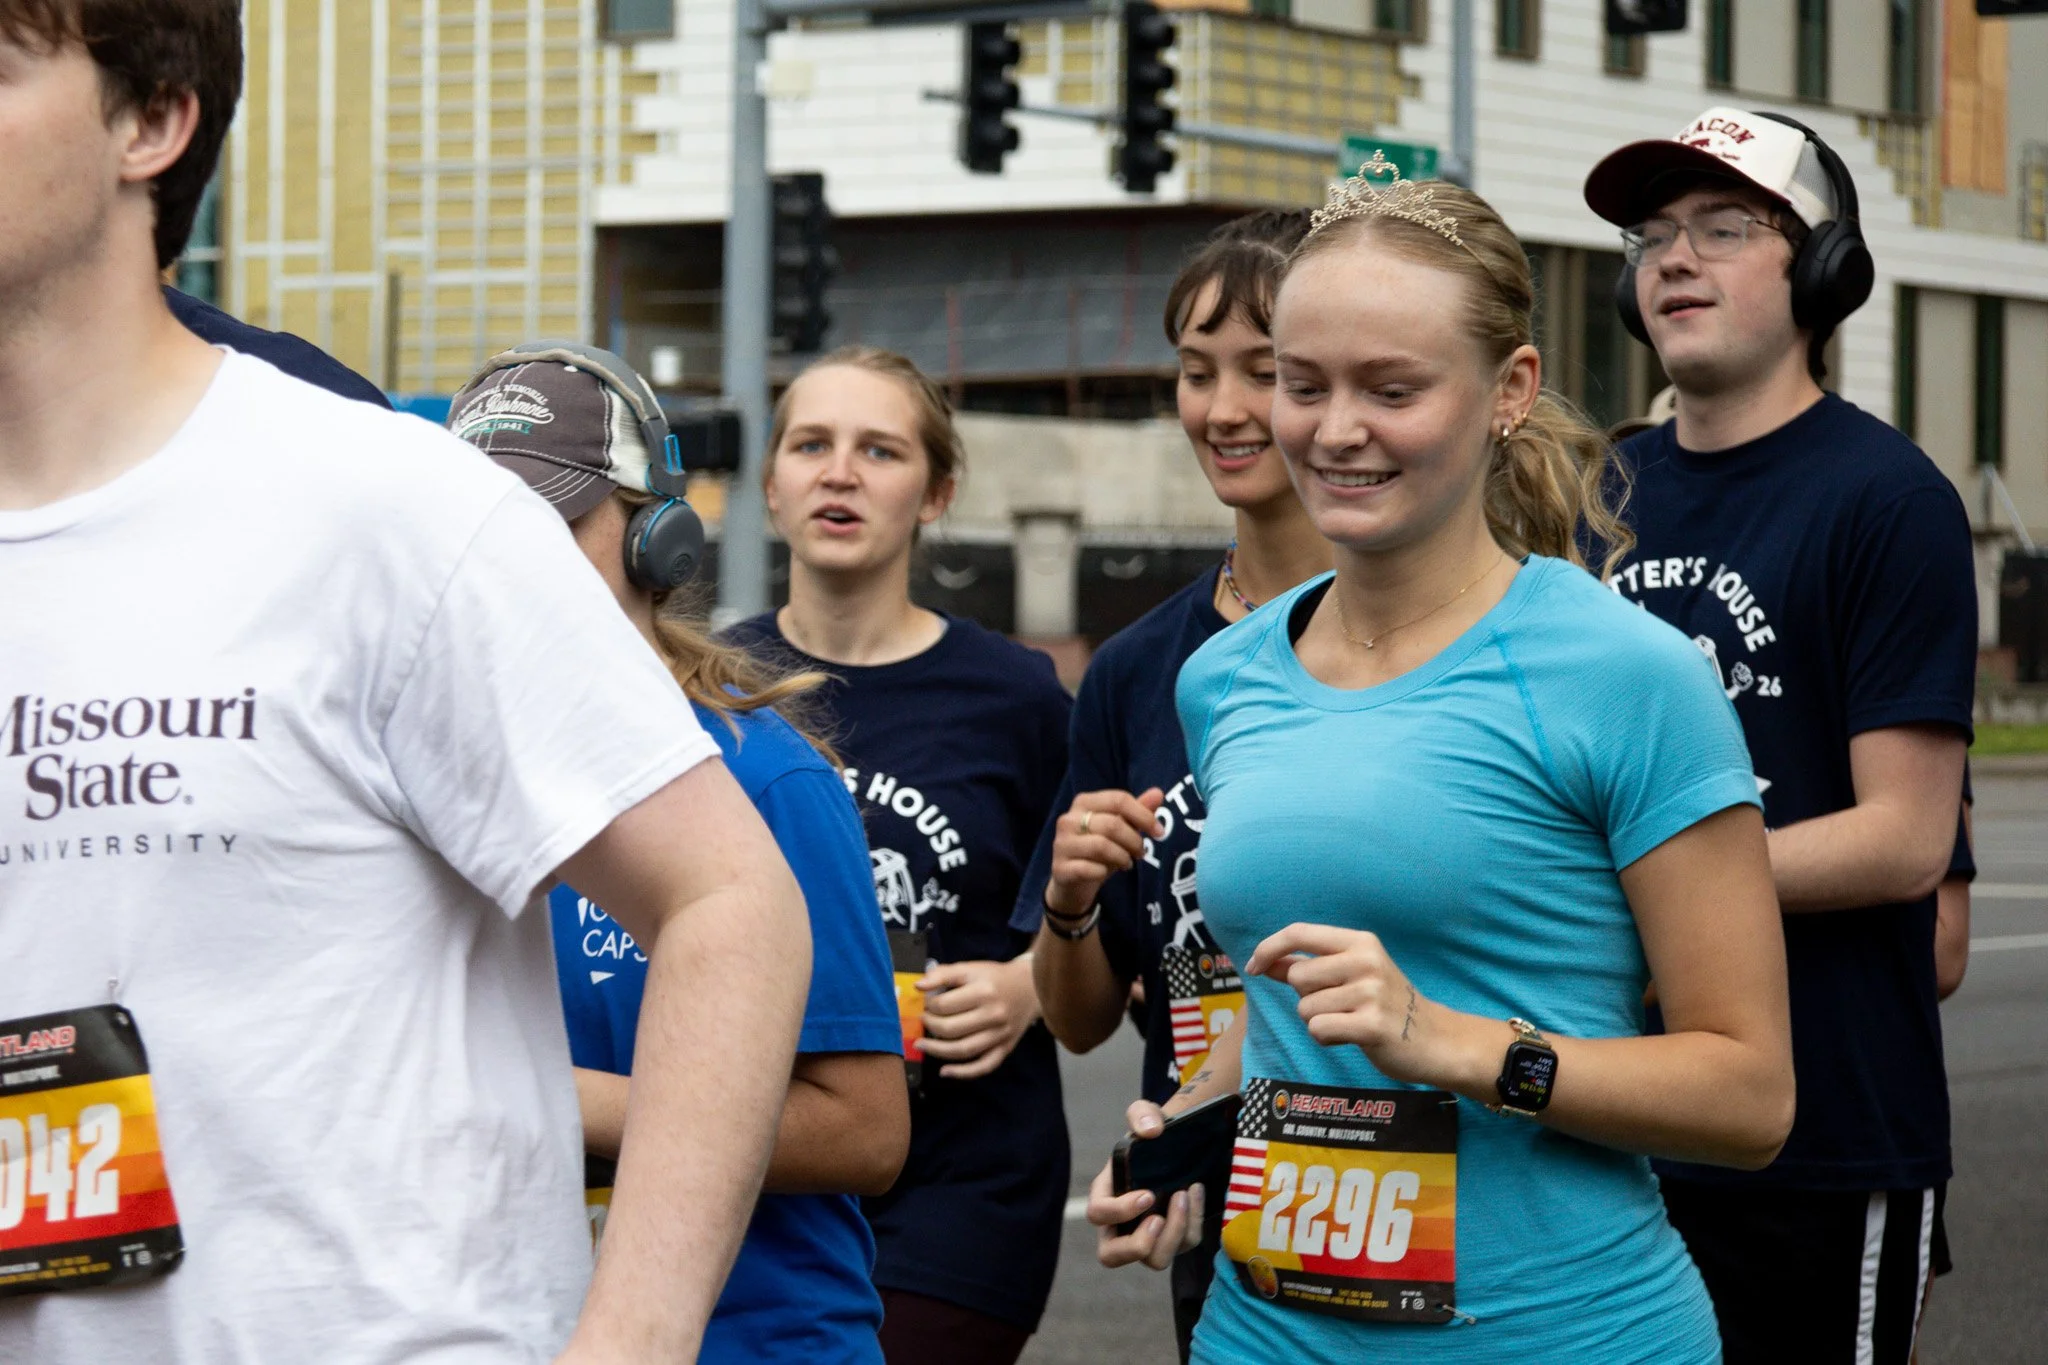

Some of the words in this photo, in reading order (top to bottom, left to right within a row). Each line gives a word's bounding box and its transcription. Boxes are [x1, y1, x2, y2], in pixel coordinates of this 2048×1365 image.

[1756, 674, 1783, 698] 26
[0, 687, 258, 757] Missouri
[866, 772, 969, 872] HOUSE
[0, 834, 237, 864] UNIVERSITY
[934, 889, 961, 913] 26
[1290, 1093, 1396, 1118] HEARTLAND
[1328, 1128, 1377, 1142] MULTISPORT.
[1257, 1161, 1421, 1263] 2296
